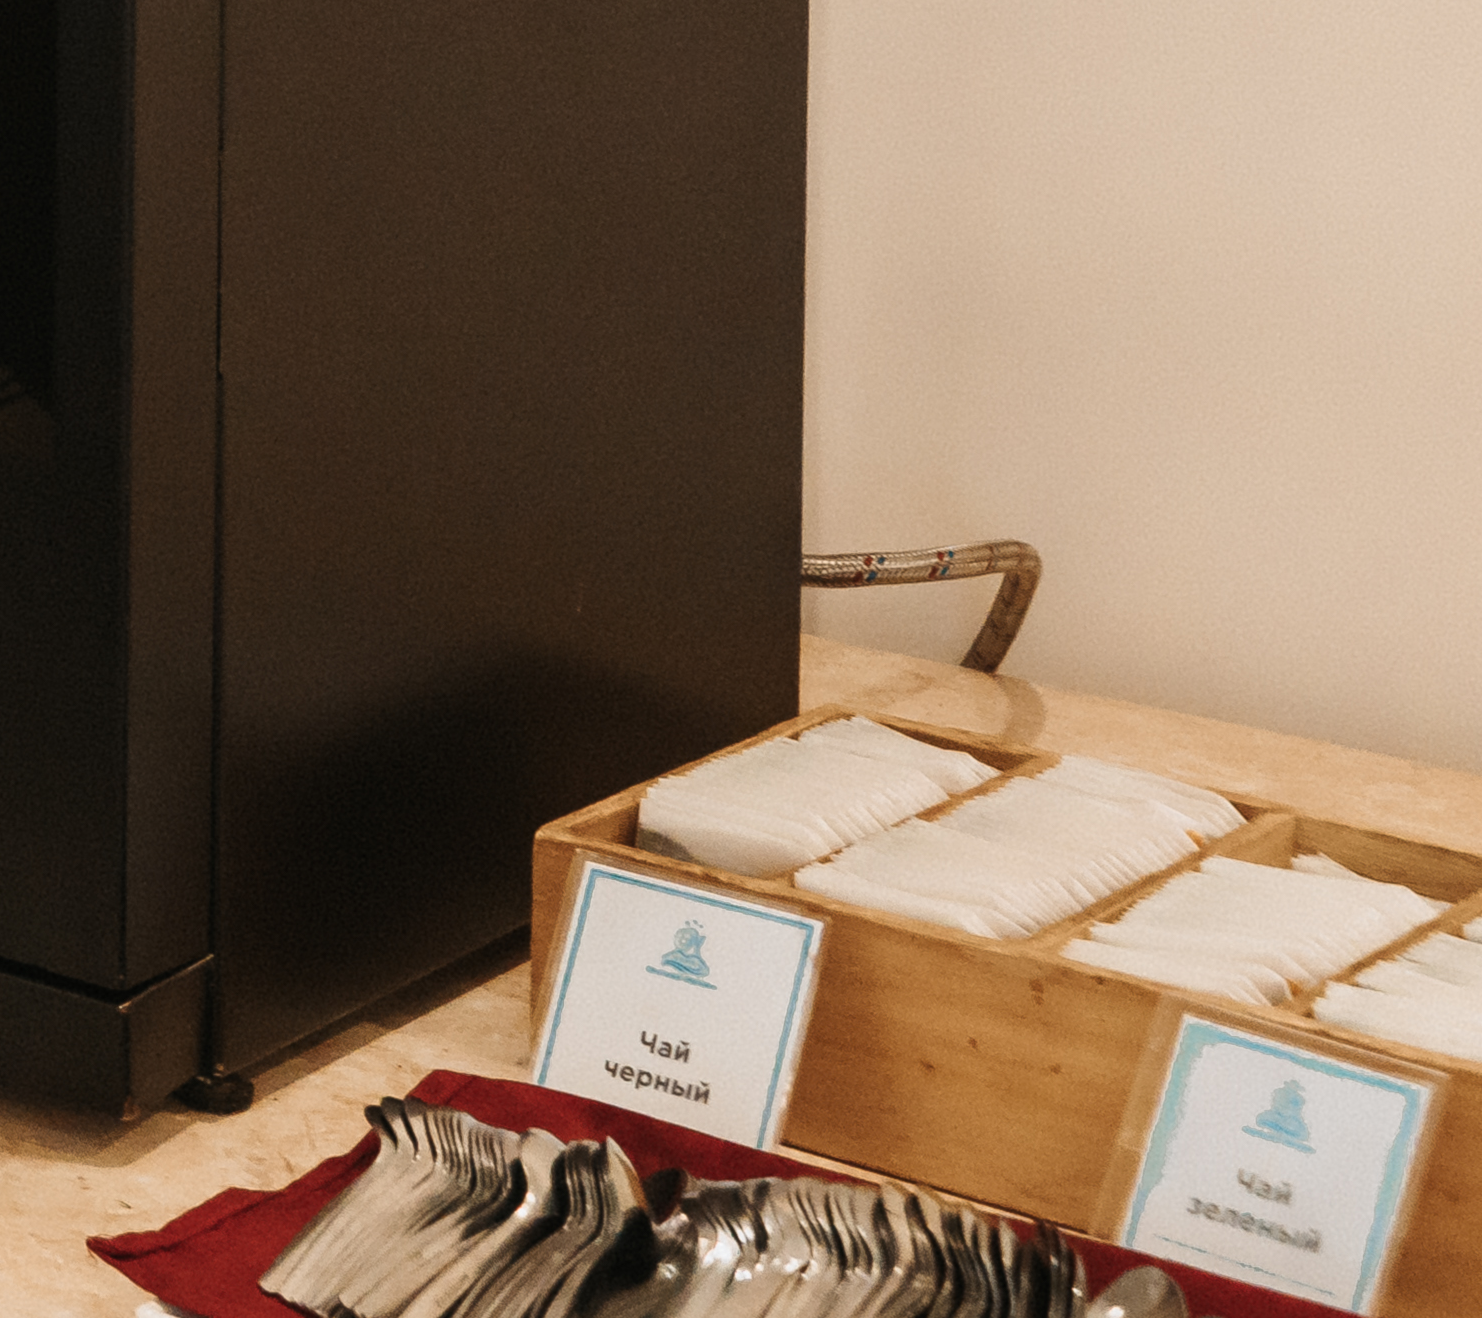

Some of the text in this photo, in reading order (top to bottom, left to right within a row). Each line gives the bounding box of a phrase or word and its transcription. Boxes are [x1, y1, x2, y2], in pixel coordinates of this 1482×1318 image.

[640, 1030, 691, 1064] Чай
[604, 1059, 711, 1104] черный
[1237, 1168, 1293, 1205] Чай
